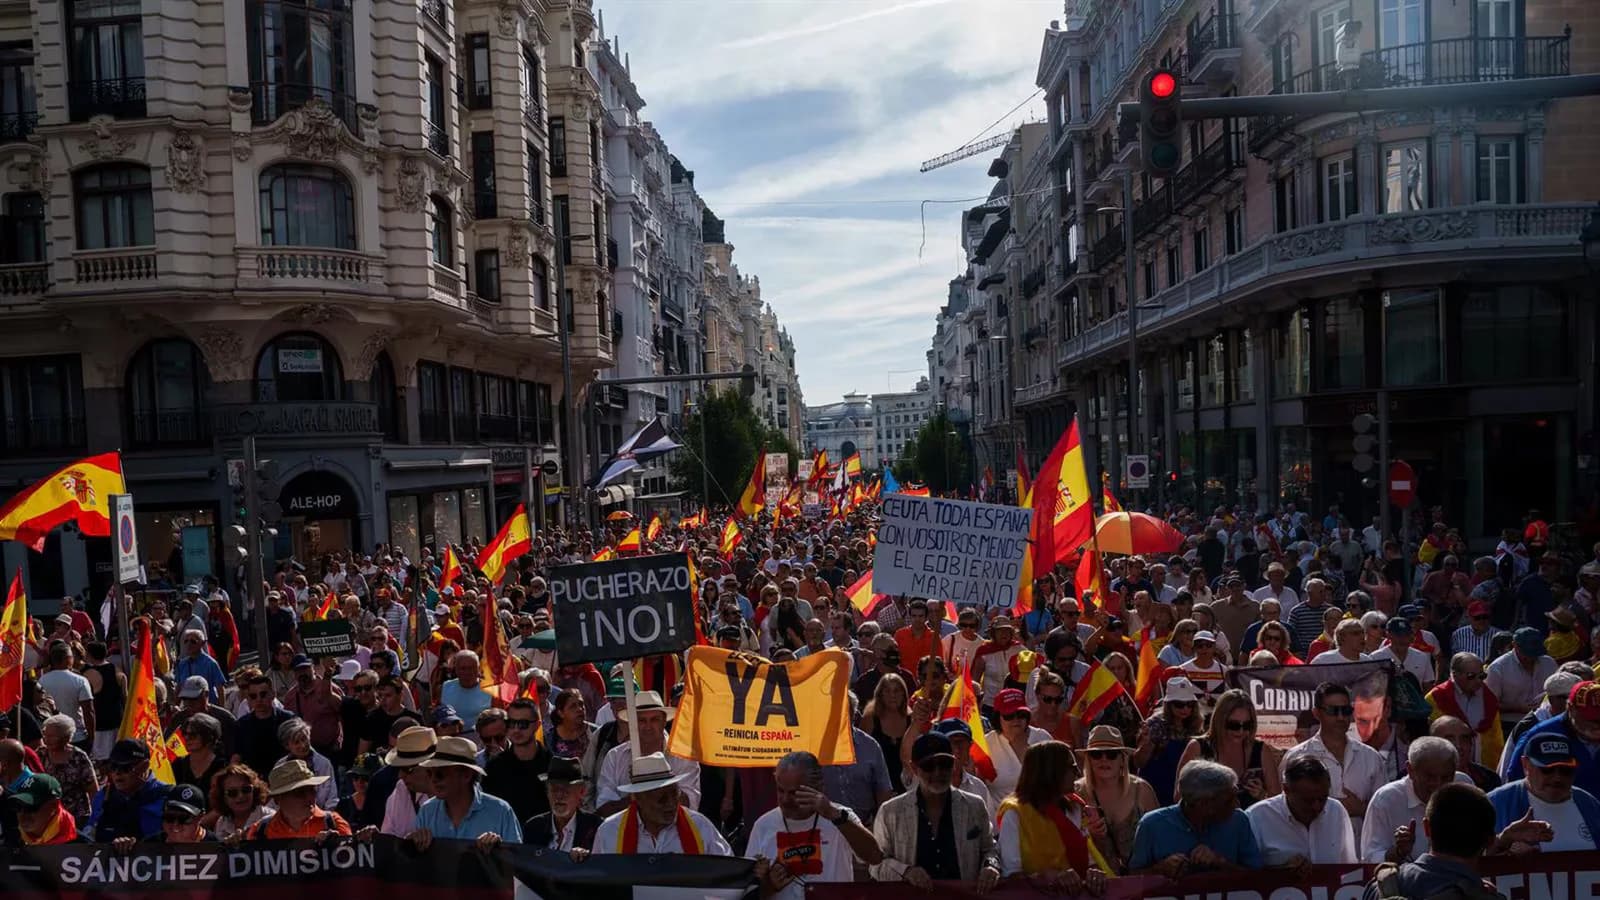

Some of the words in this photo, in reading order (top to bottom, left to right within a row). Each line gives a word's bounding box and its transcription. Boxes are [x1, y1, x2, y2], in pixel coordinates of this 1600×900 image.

[289, 495, 342, 510] ALE-HOP
[933, 501, 971, 528] TODA
[974, 507, 1031, 533] ESPAÑA
[877, 523, 905, 547] CON
[907, 527, 978, 556] VOSOTROS
[979, 534, 1026, 561] MENOS
[893, 550, 914, 571] EL
[923, 554, 1019, 581] GOBIERNO
[550, 566, 691, 604] PUCHERAZO
[911, 573, 1013, 608] MARCIANO
[725, 660, 799, 727] YA
[724, 728, 759, 740] REINICIA
[760, 729, 793, 741] ESPAÑA
[60, 850, 219, 884] SÁNCHEZ
[228, 840, 376, 878] DIMISIÓN
